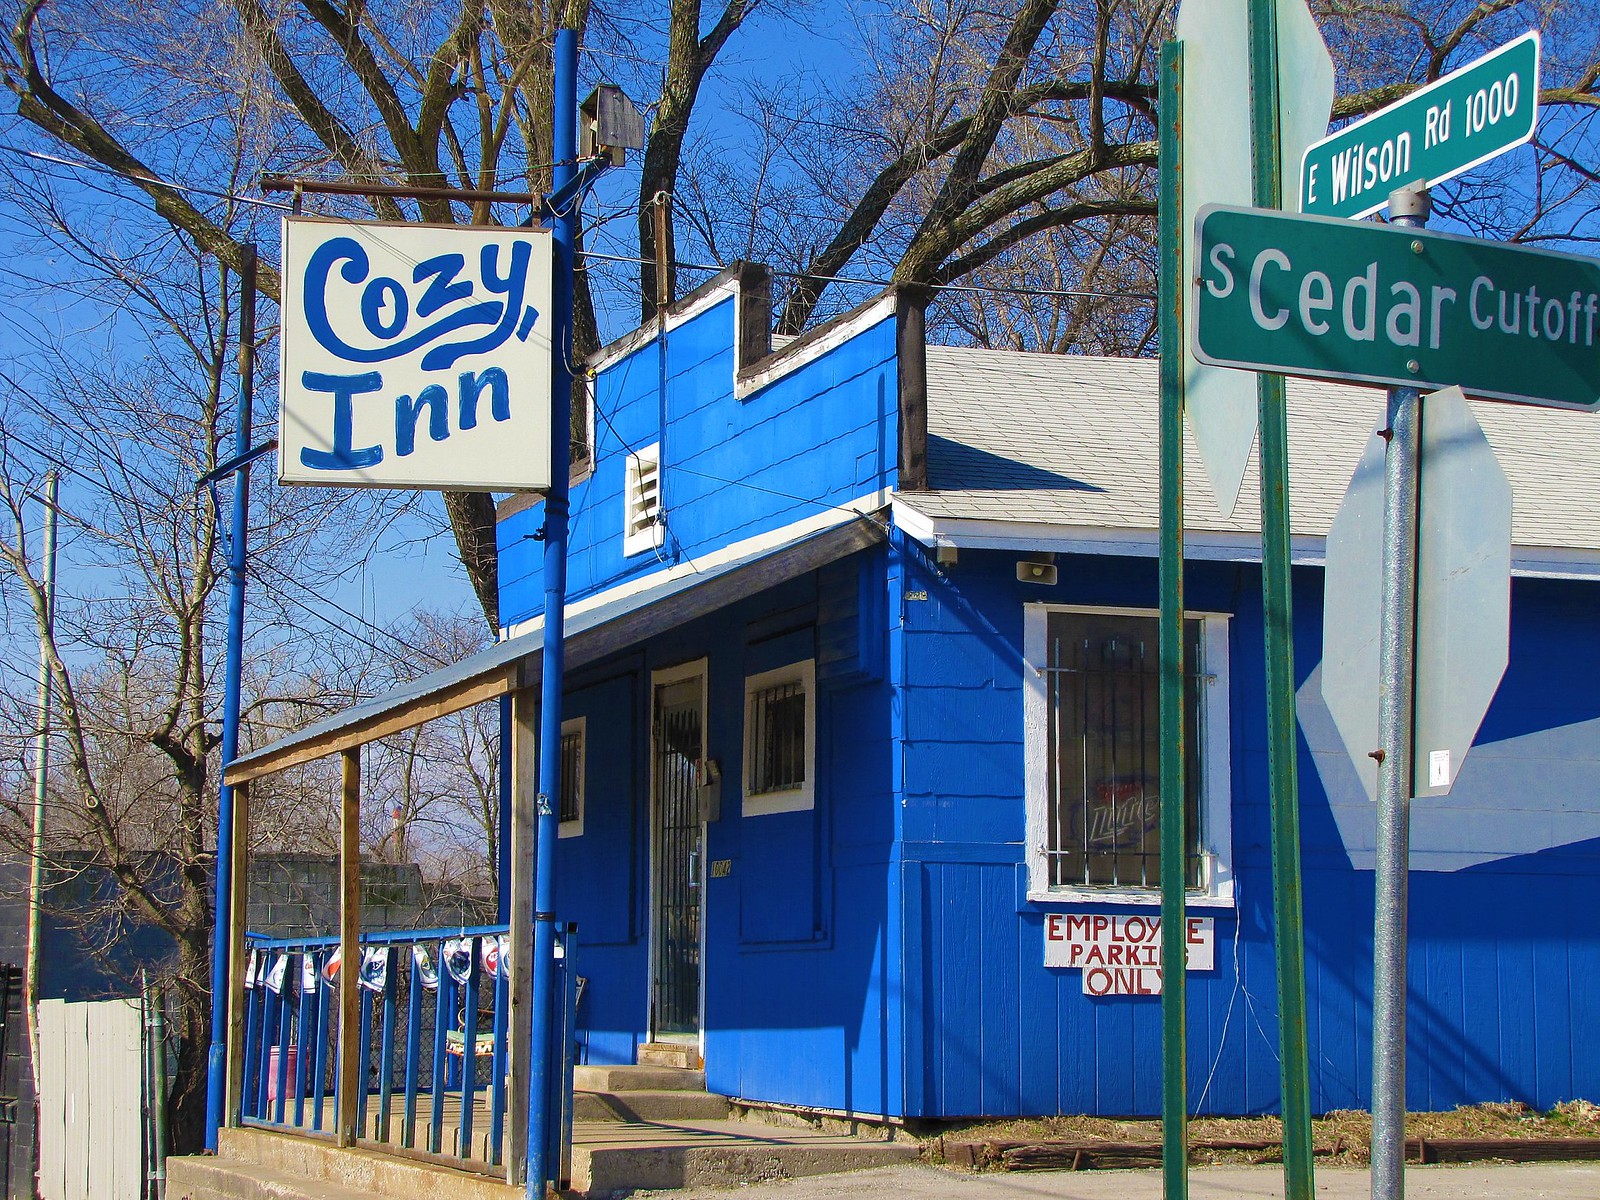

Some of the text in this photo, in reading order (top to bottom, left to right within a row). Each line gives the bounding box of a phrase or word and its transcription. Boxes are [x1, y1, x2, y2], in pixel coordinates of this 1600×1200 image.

[1307, 72, 1519, 206] E Wilson Rd 1000
[1206, 243, 1598, 350] S Cedar Cutoff
[300, 366, 511, 471] Inn
[1048, 914, 1205, 944] EMPLOYE
[1070, 944, 1189, 966] PARKI
